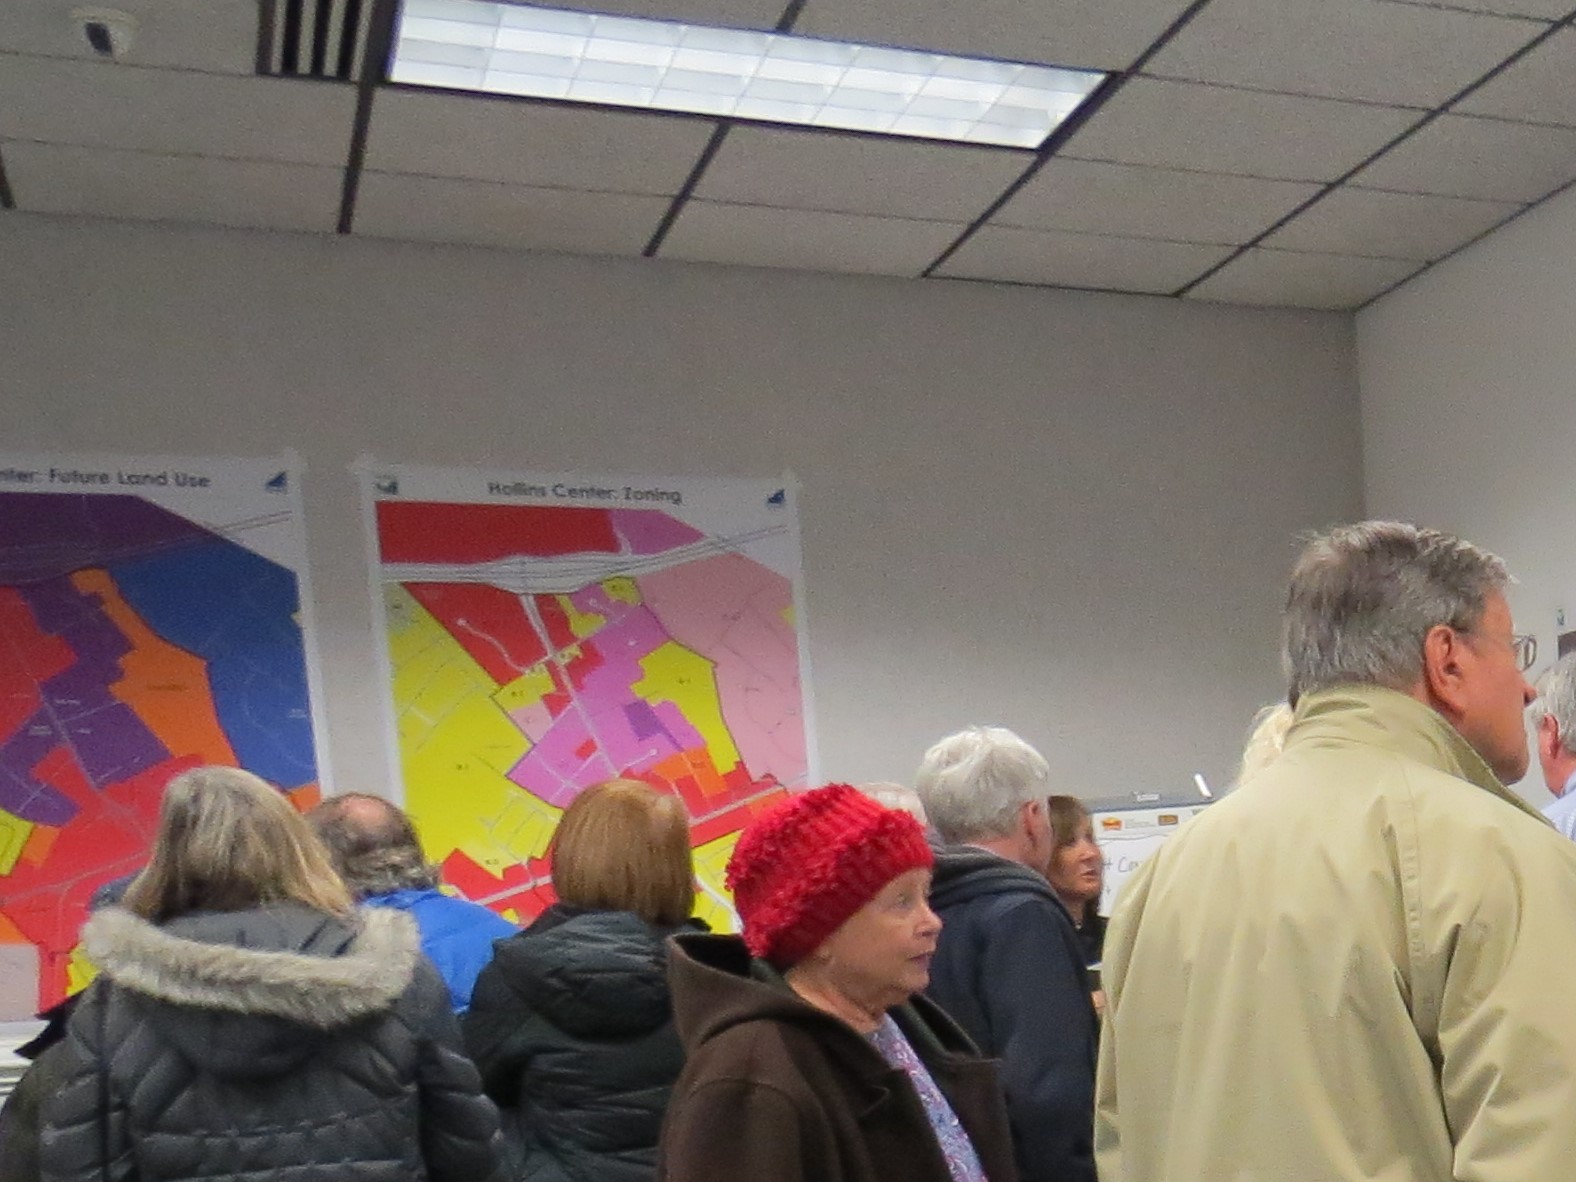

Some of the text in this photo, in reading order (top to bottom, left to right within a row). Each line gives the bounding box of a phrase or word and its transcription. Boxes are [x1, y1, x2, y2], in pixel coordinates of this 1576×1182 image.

[49, 467, 109, 485] Future
[117, 469, 168, 487] Land
[174, 471, 211, 488] Use
[487, 481, 547, 497] Hollins
[622, 485, 682, 506] Zoning
